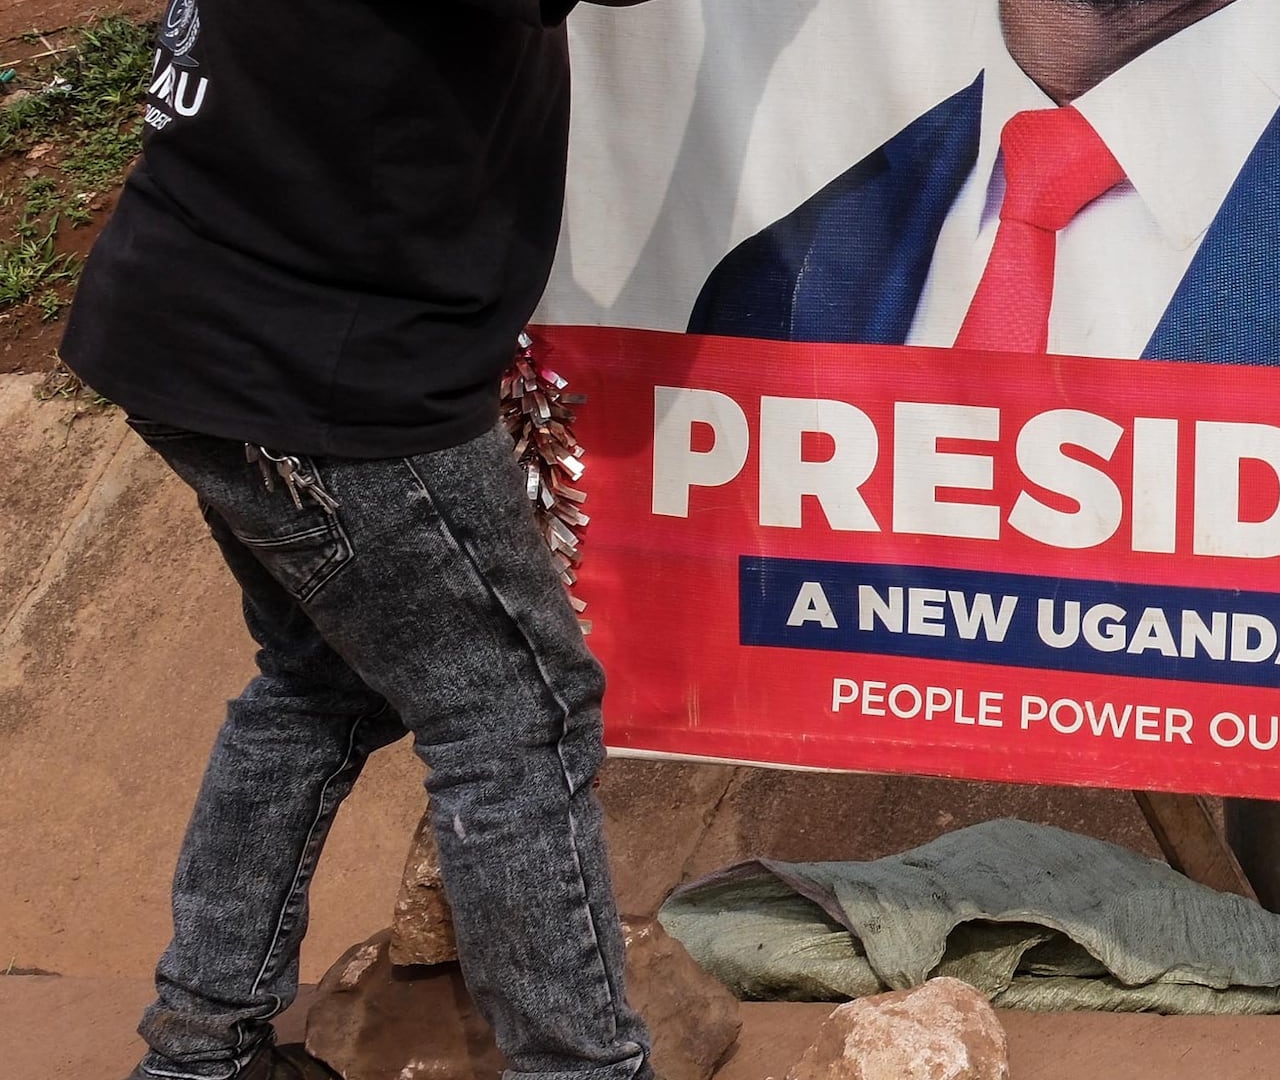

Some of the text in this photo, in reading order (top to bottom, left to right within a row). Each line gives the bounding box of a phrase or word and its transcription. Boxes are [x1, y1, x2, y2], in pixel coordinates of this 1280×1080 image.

[786, 581, 838, 629] A
[857, 584, 1018, 642] NEW
[831, 678, 1004, 728] PEOPLE
[1020, 695, 1194, 745] POWER
